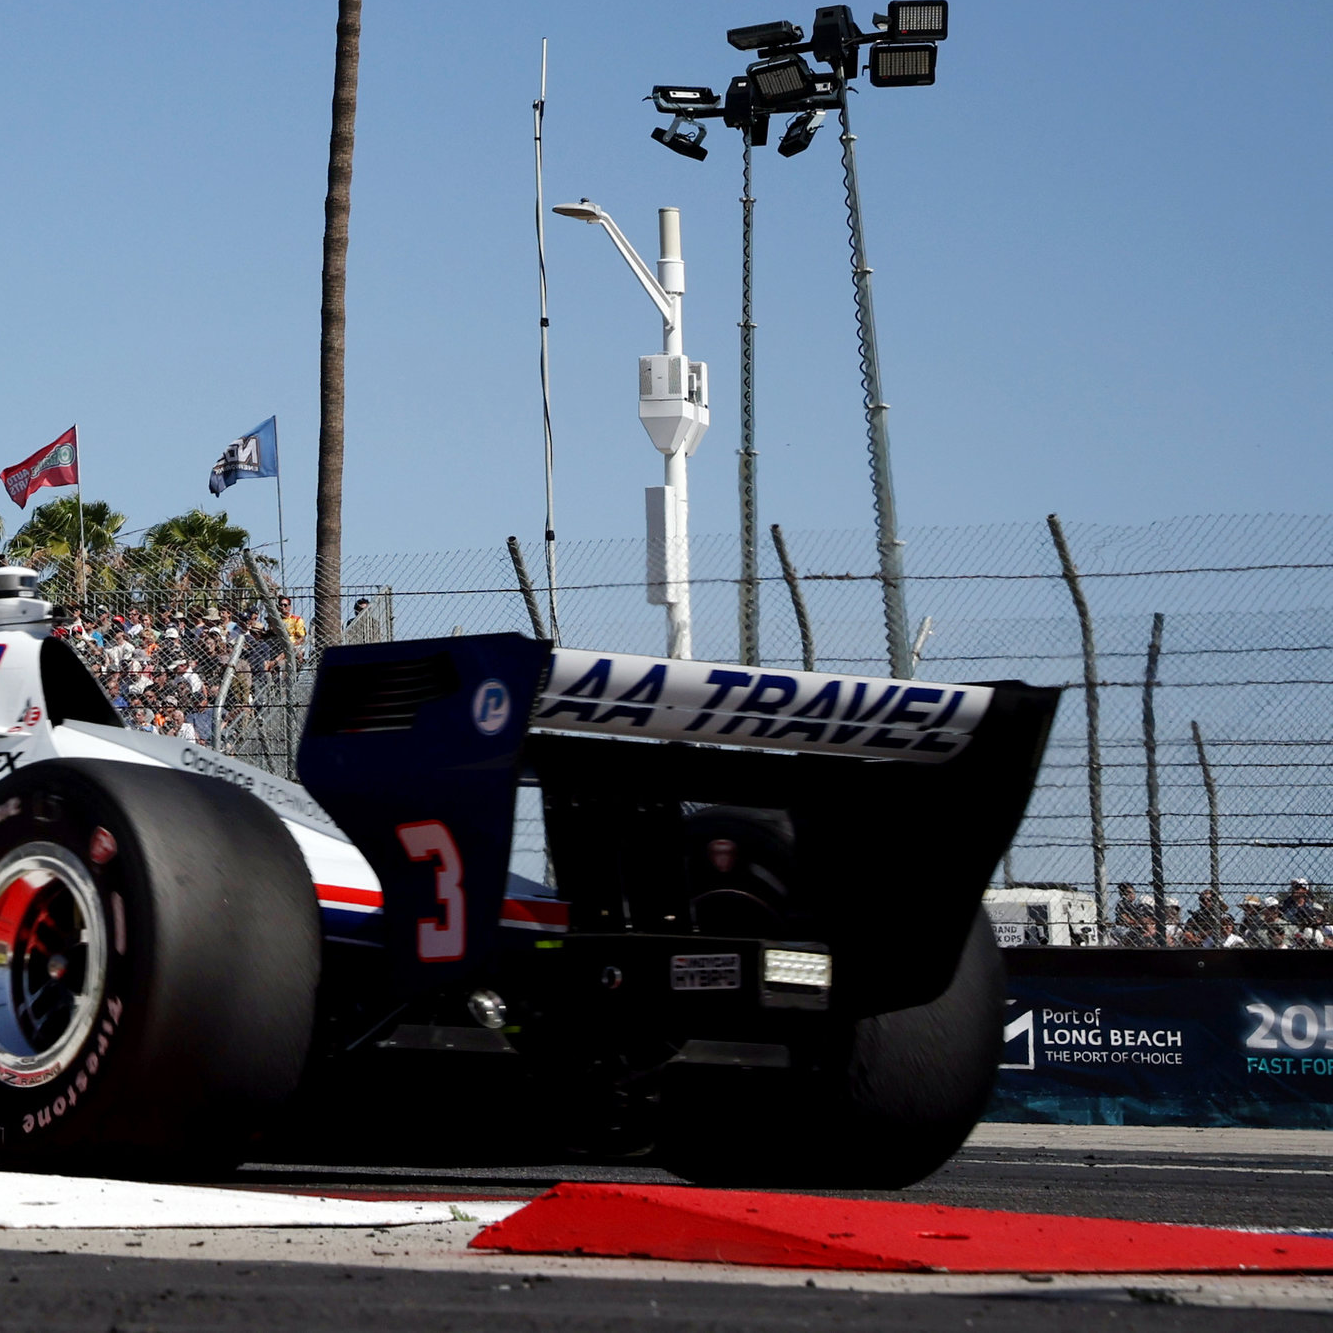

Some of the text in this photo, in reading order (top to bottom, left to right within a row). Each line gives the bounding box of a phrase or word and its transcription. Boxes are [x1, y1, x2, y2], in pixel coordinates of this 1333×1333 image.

[536, 654, 965, 753] AA TRAVEL
[395, 819, 467, 963] 3
[1042, 1008, 1101, 1027] Port of
[1246, 1003, 1333, 1050] 20
[1043, 1028, 1182, 1047] LONG BEACH
[1045, 1050, 1183, 1065] THE PORT OF CHOICE
[1247, 1057, 1297, 1075] FAST.
